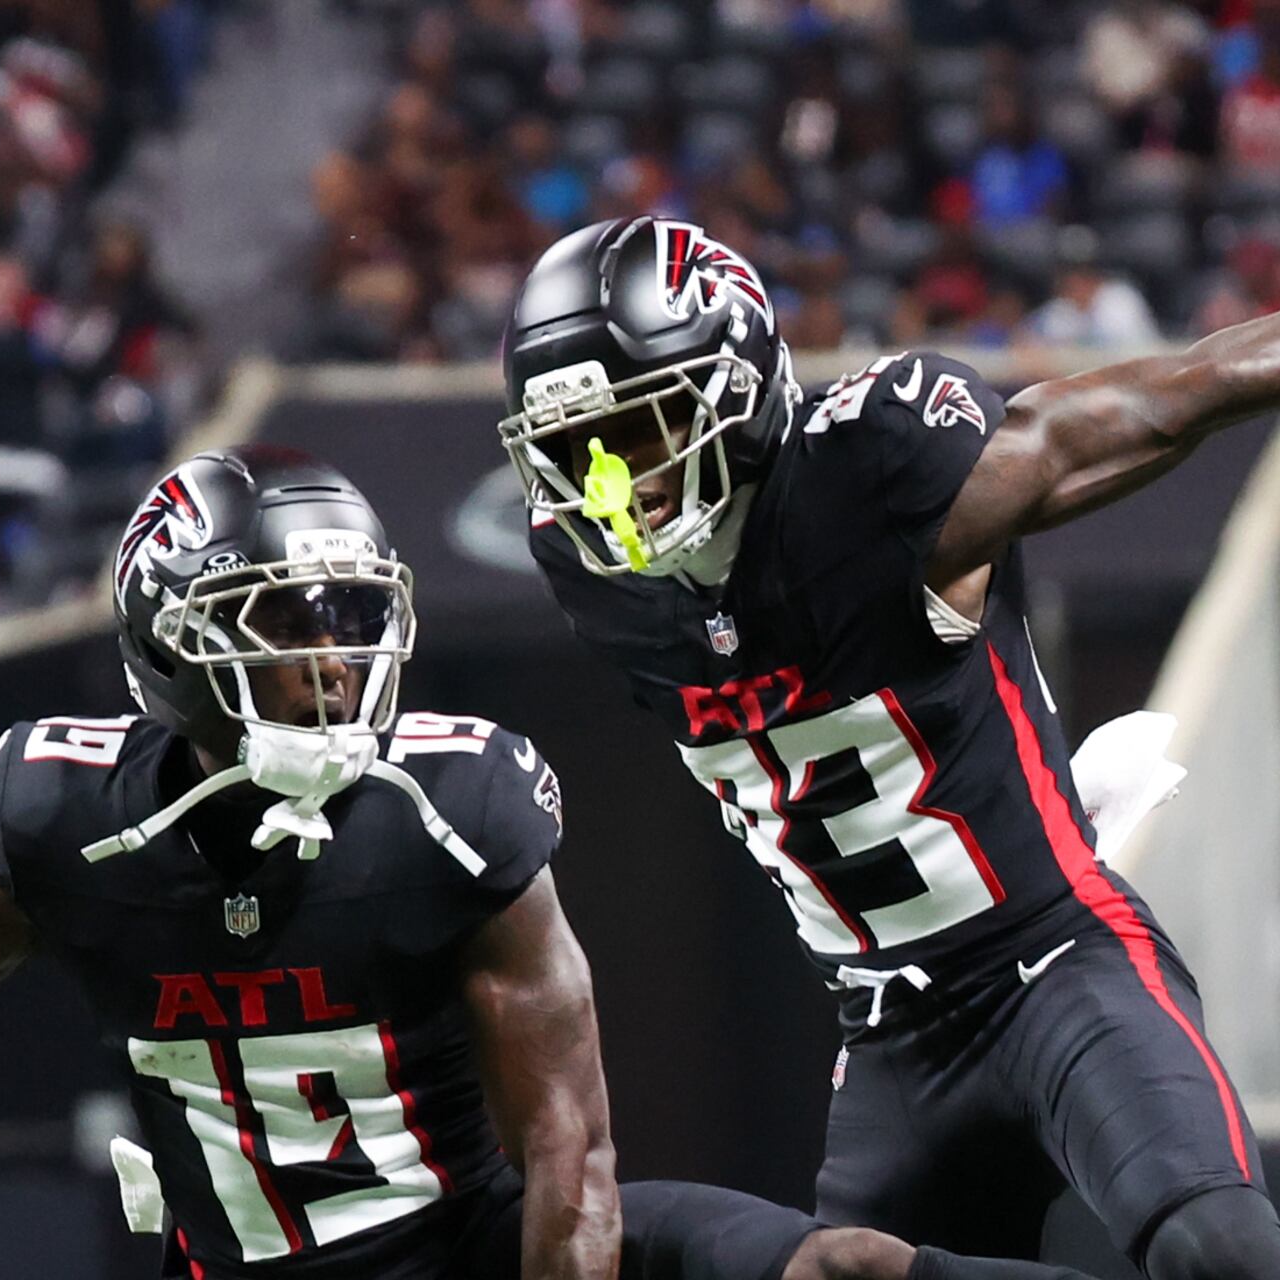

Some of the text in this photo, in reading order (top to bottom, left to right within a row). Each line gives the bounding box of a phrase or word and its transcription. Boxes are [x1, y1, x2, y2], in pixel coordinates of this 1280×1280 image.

[679, 665, 832, 737] ATL
[153, 967, 358, 1028] ATL
[128, 1022, 451, 1263] 19
